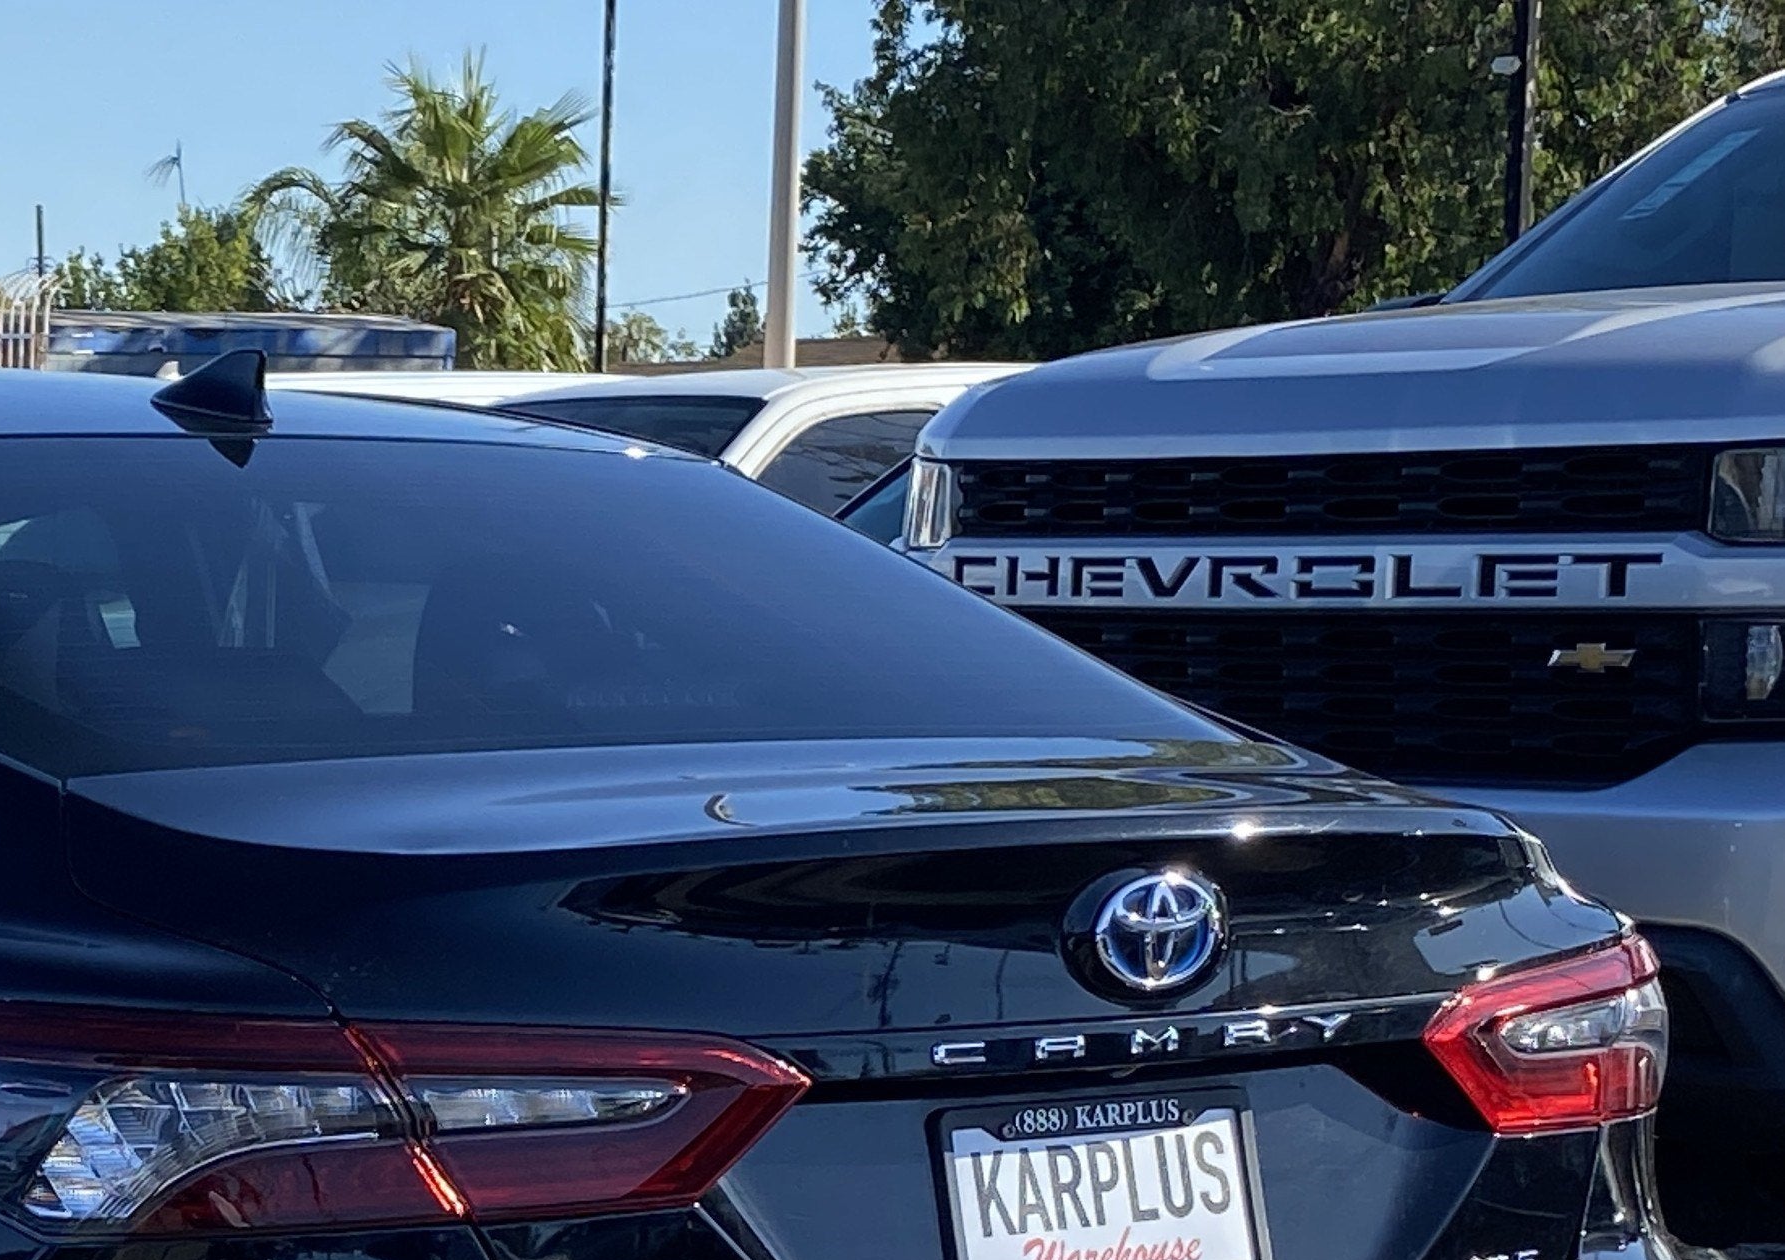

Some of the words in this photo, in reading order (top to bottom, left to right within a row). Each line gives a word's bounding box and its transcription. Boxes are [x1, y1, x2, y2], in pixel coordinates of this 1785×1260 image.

[953, 551, 1663, 600] CHEVROLET
[933, 1013, 1352, 1064] CAMRY
[1015, 1107, 1069, 1134] (888)
[1074, 1099, 1180, 1129] KARPLUS
[971, 1131, 1231, 1237] KARPLUS
